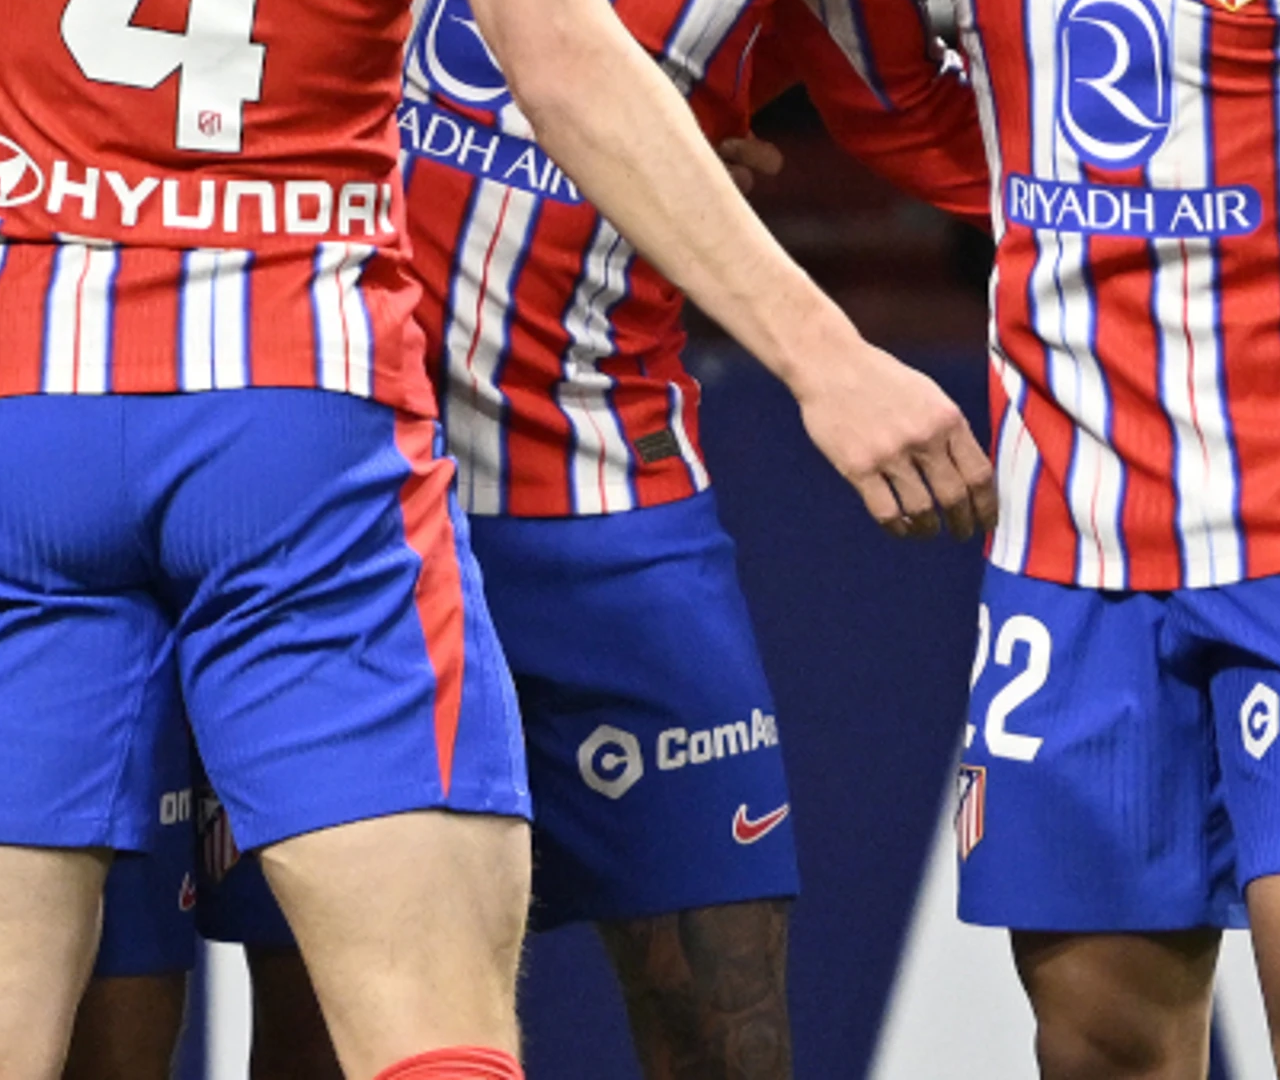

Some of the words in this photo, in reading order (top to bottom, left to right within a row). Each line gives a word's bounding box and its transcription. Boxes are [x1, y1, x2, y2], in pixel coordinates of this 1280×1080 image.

[396, 104, 500, 172] ADH
[1010, 176, 1155, 232] RIYADH
[1170, 189, 1252, 233] AIR
